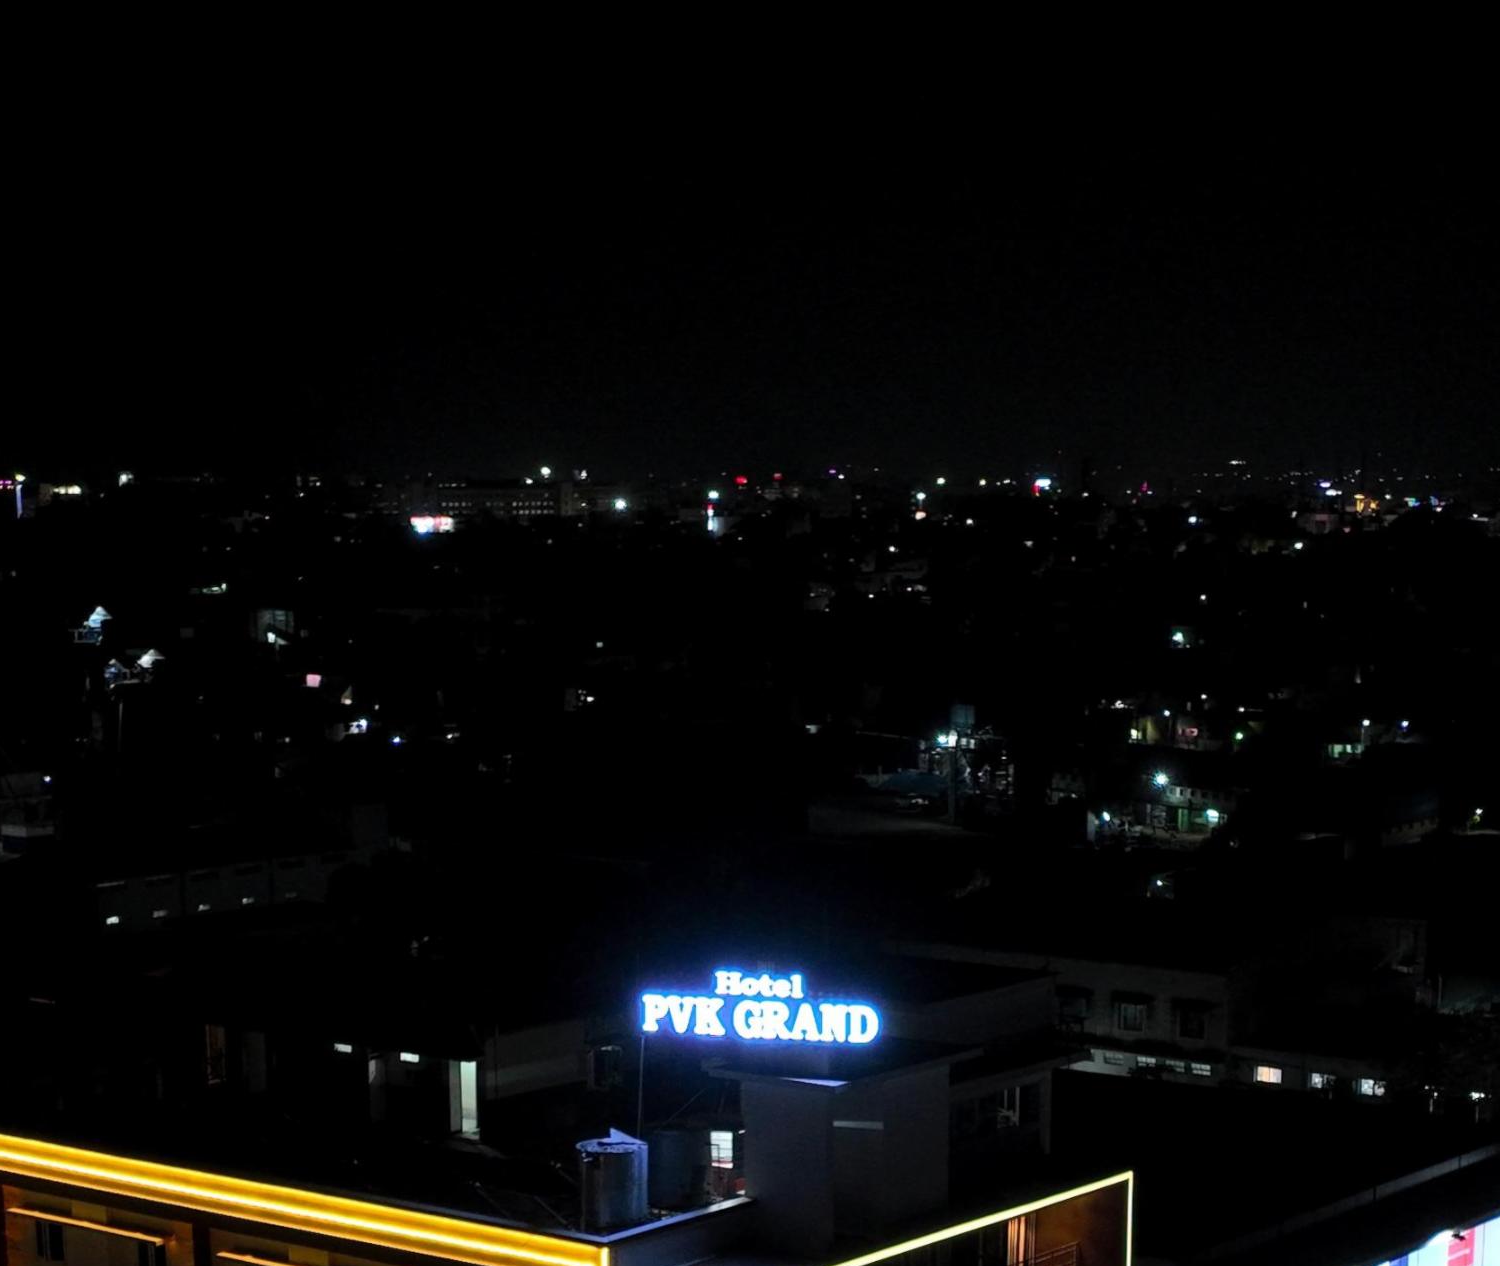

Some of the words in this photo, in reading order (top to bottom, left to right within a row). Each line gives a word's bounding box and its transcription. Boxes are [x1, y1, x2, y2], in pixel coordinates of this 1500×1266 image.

[714, 970, 804, 999] Hotel
[641, 994, 726, 1037] PVK
[732, 999, 880, 1044] GRAND
